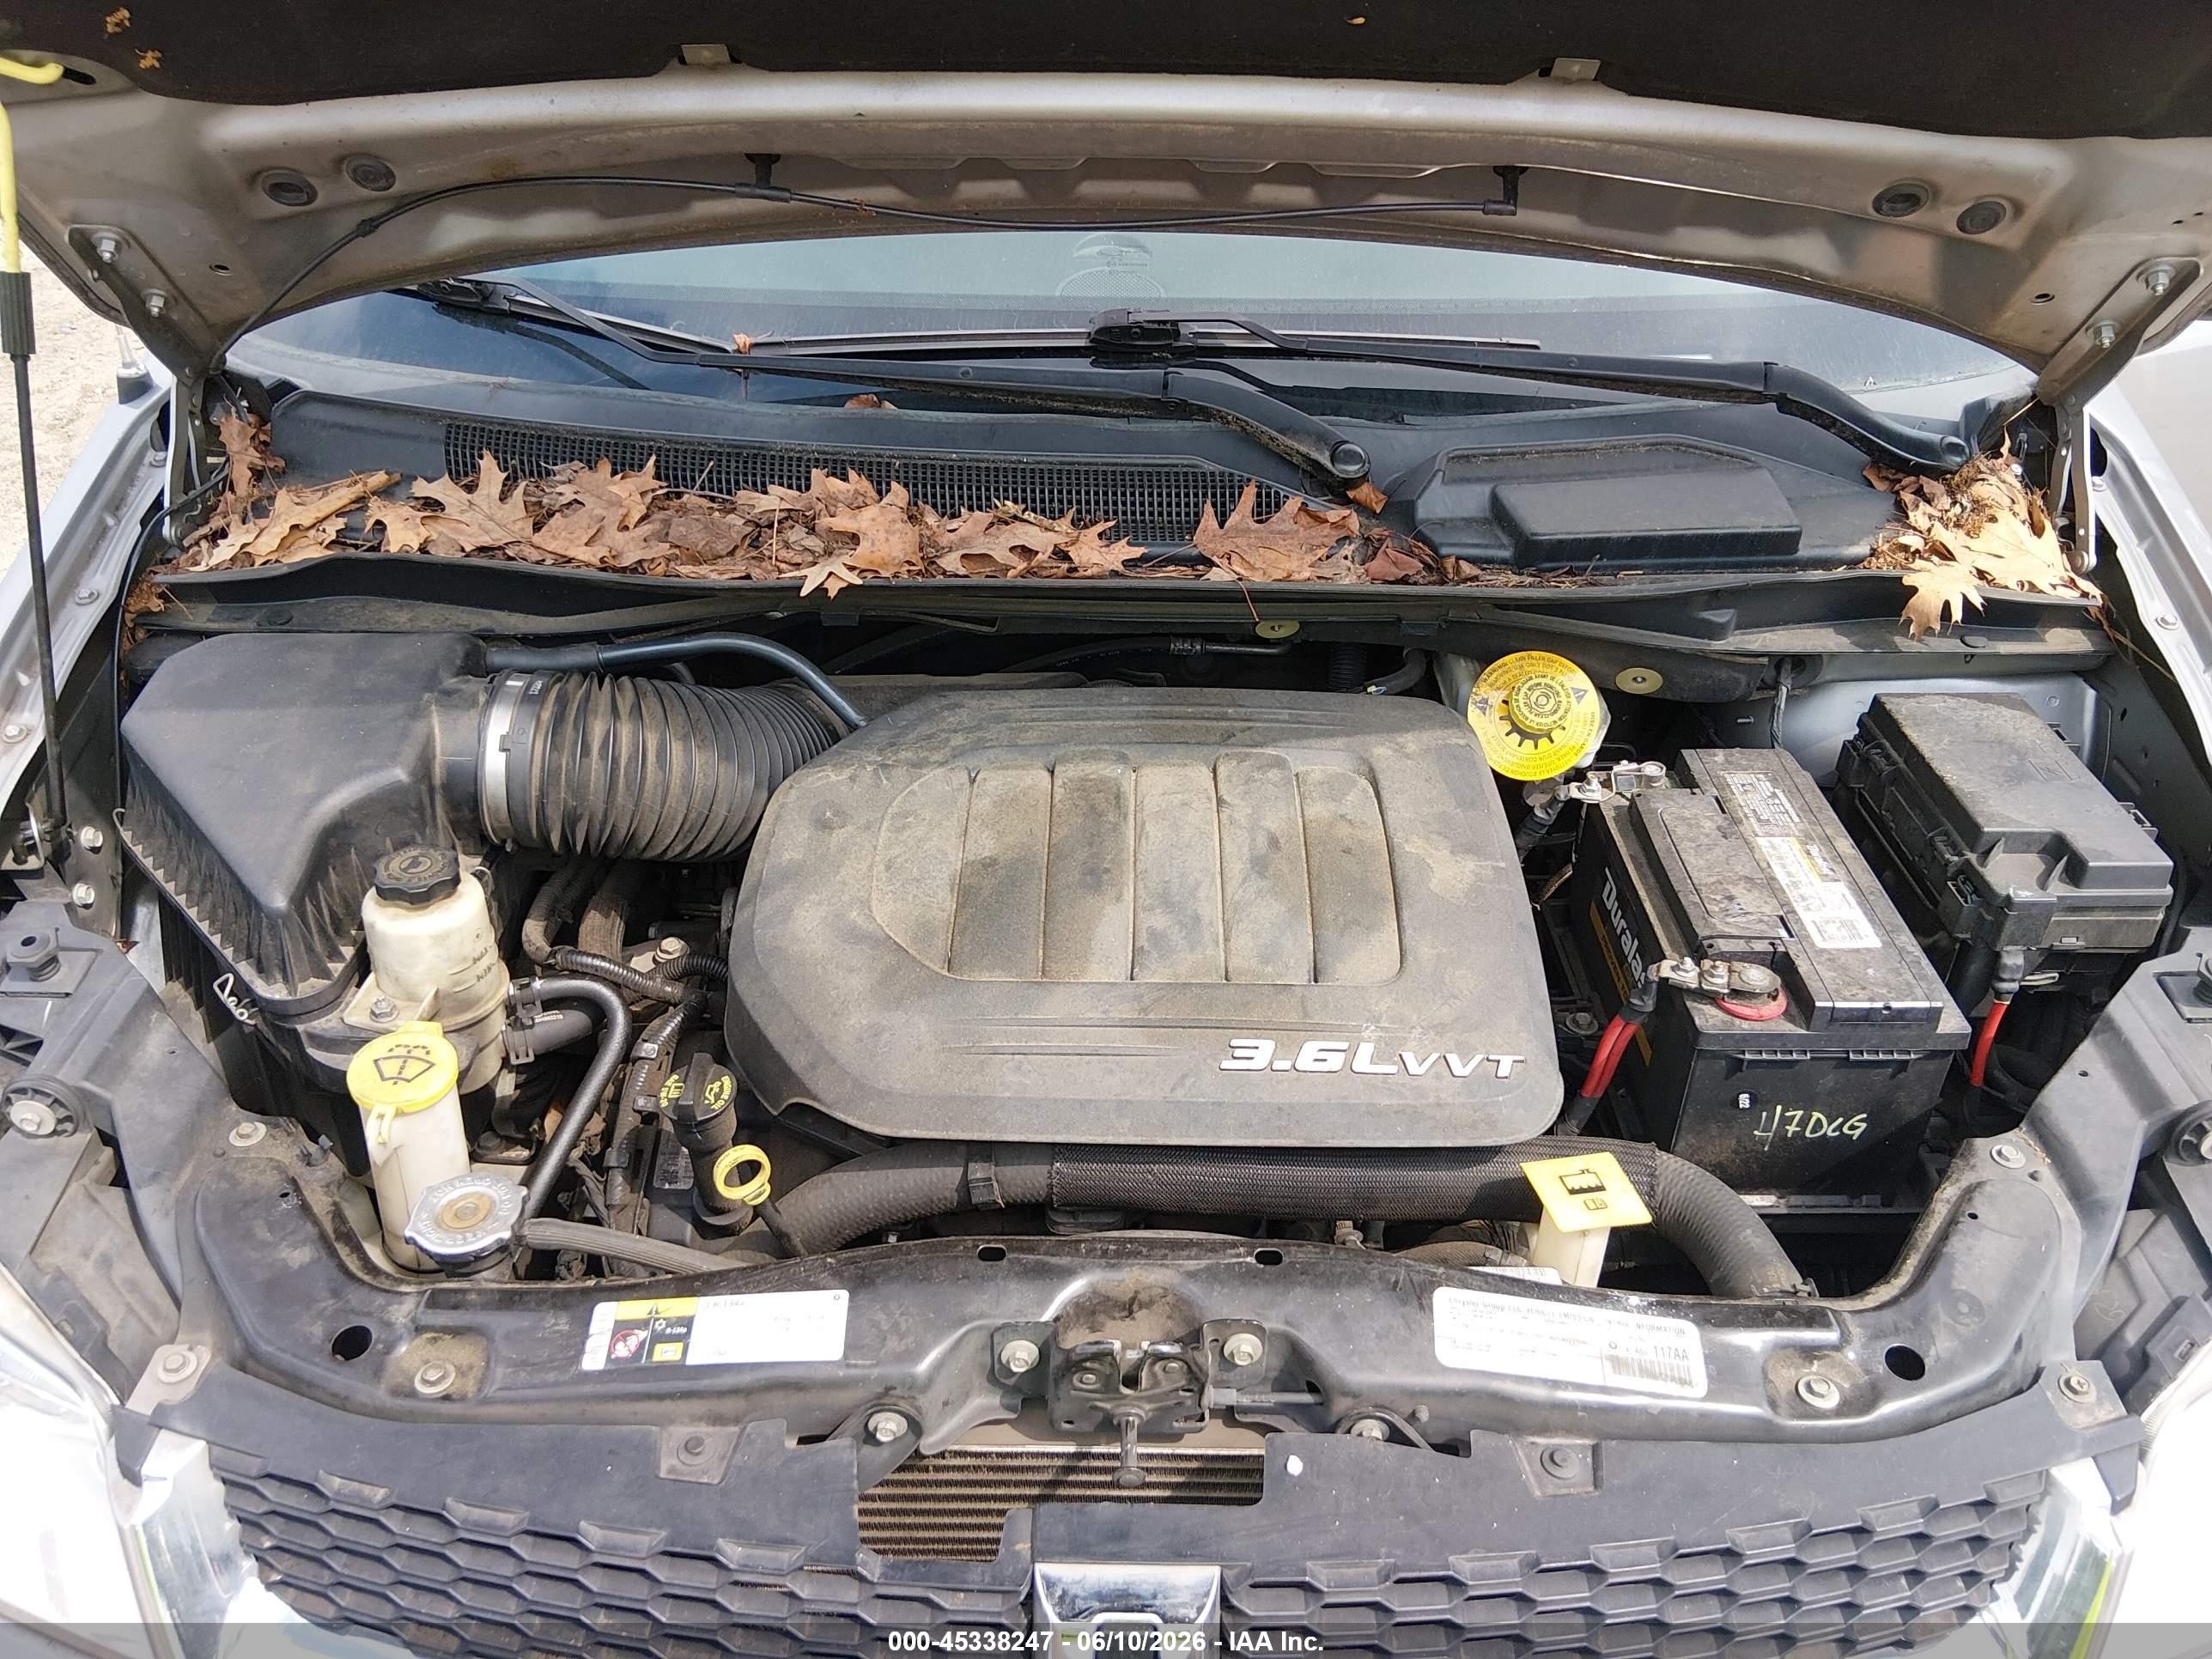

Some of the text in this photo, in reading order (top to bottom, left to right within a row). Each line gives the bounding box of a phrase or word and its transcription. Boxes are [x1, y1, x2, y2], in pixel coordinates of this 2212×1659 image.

[710, 1075, 732, 1110] ENGINE OIL
[1738, 1093, 1750, 1109] 6/22
[1449, 1297, 1479, 1309] Chrysler
[1482, 1300, 1505, 1312] Group
[1654, 1346, 1690, 1361] 117AA
